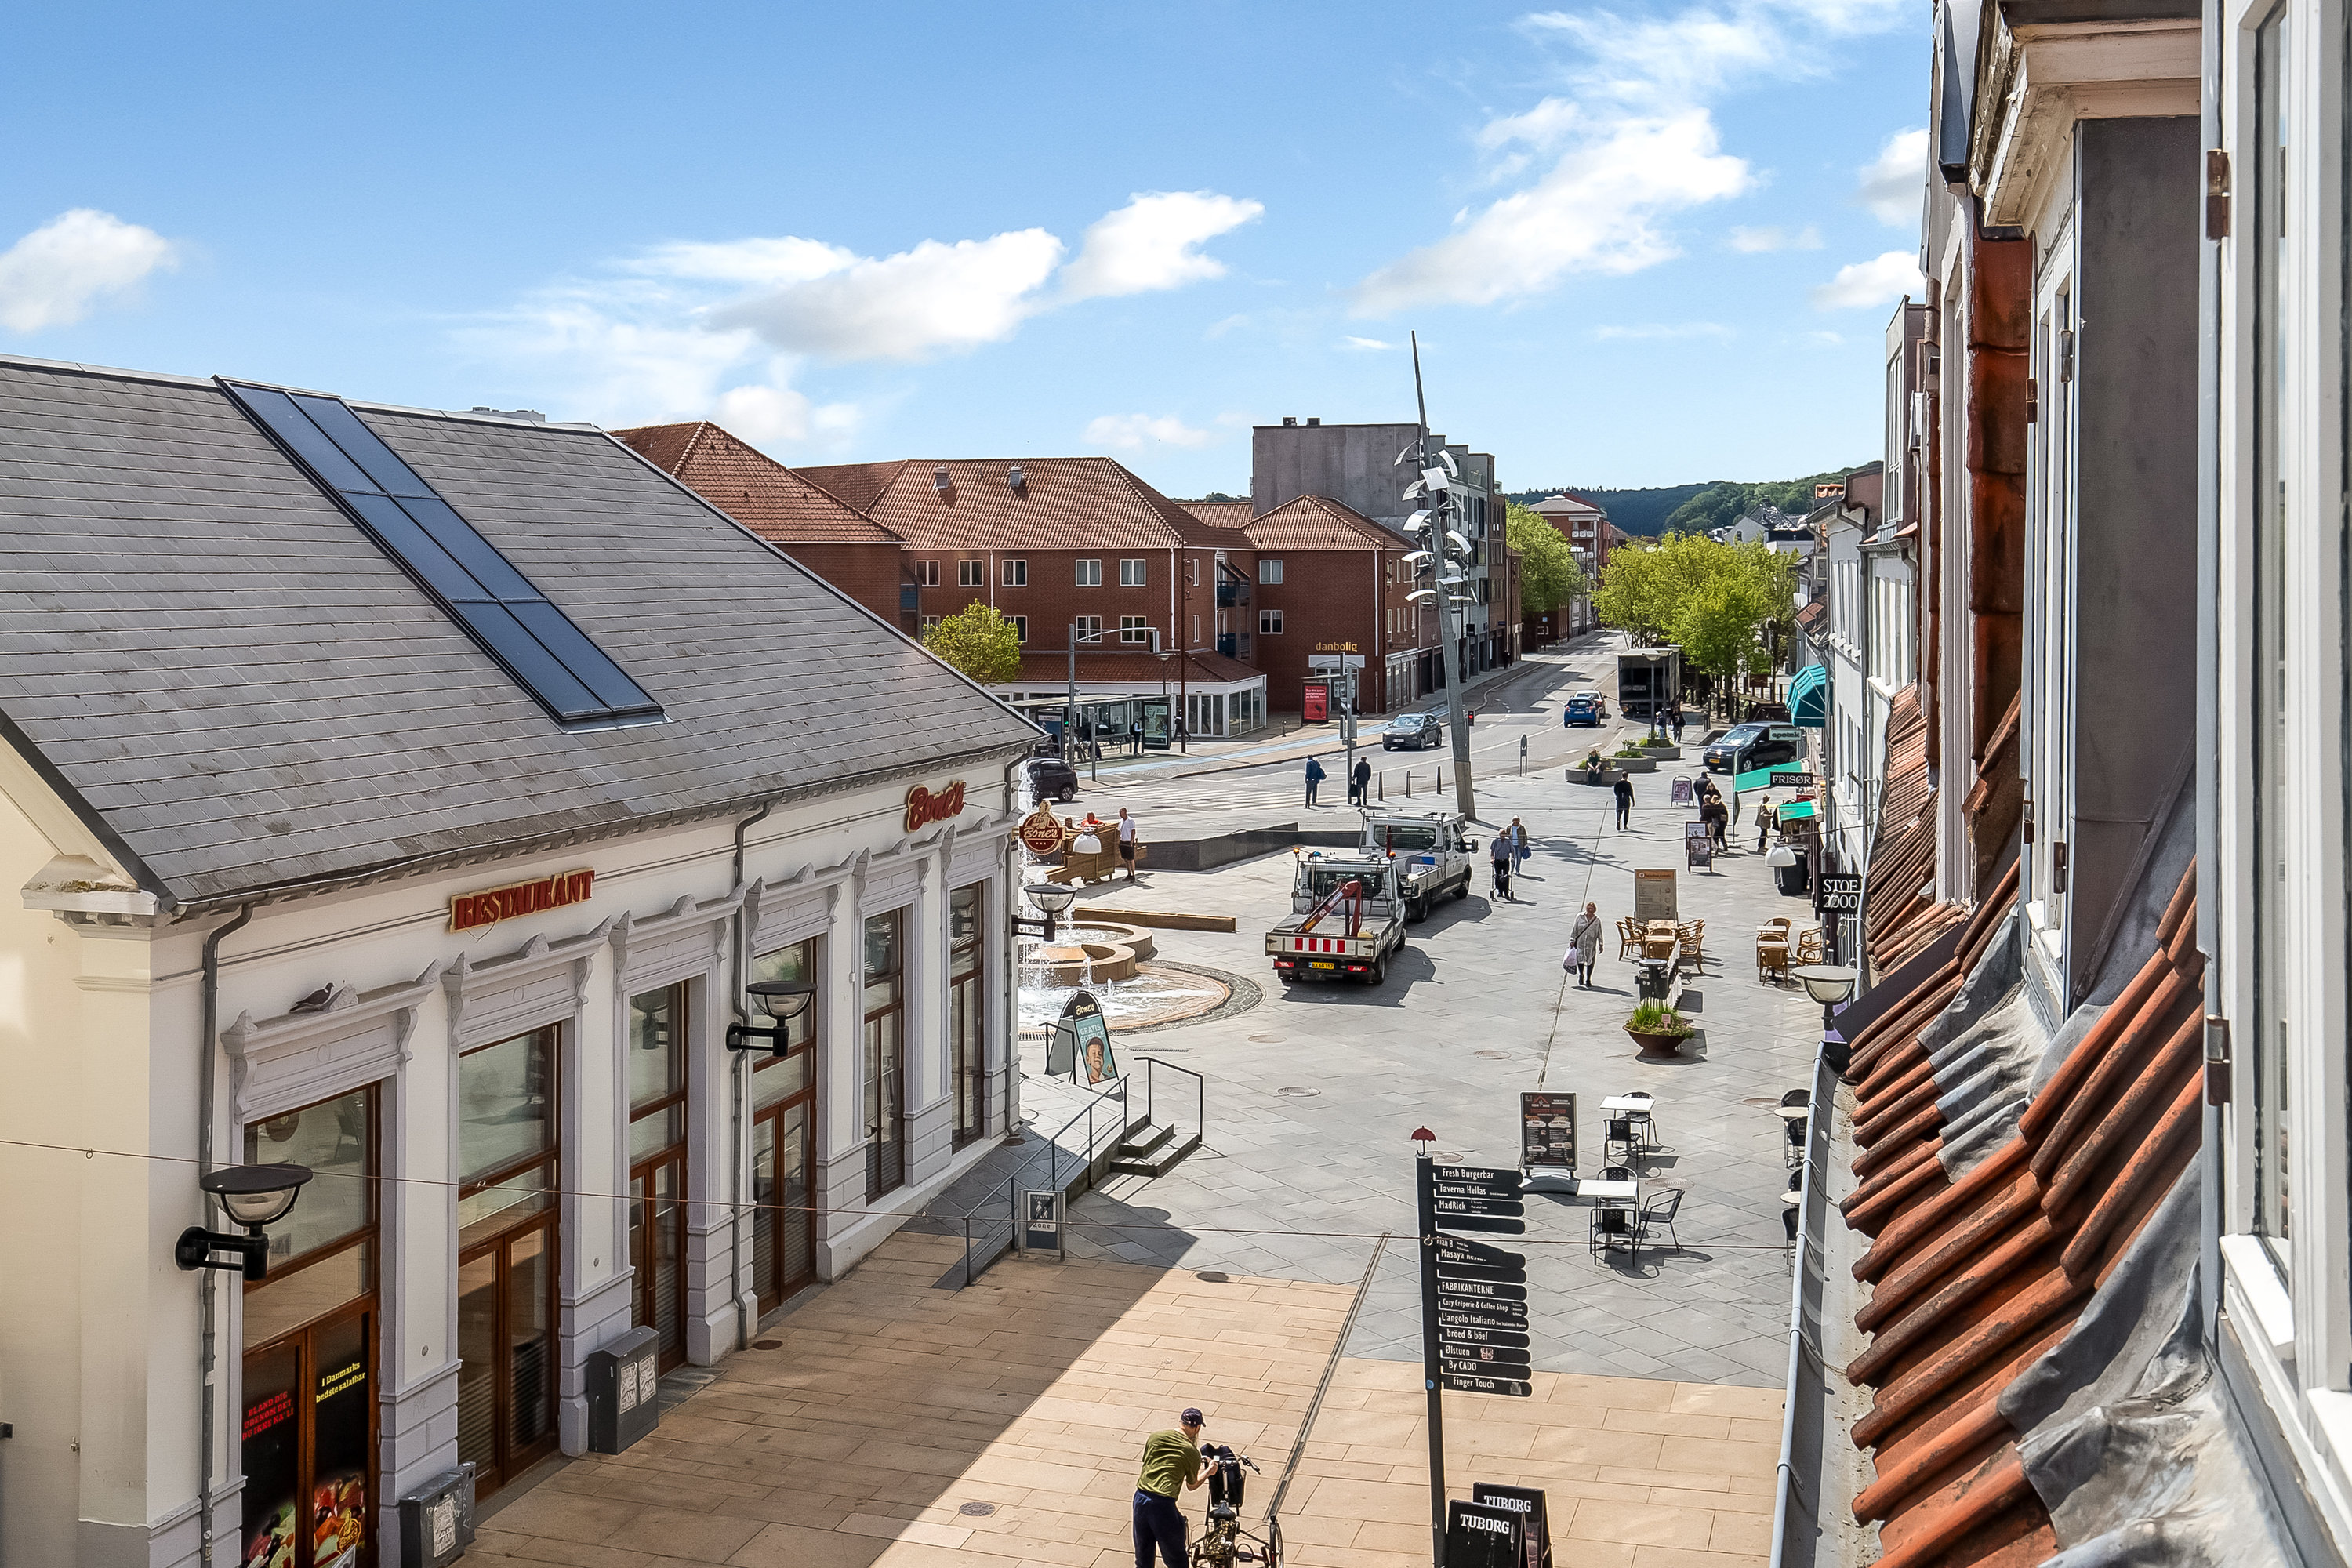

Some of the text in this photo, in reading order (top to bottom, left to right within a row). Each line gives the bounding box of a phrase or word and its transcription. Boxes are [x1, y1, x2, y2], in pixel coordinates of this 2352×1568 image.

[1316, 641, 1358, 652] danbolig
[1772, 775, 1811, 785] FRISØR
[1023, 827, 1059, 838] Bone's
[453, 869, 596, 931] RESTAURANT
[1823, 895, 1858, 909] 2000
[1075, 1003, 1095, 1015] Bone's
[1080, 1024, 1102, 1036] GRATIS
[1443, 1167, 1494, 1181] Fresh Burgerbar
[1439, 1184, 1465, 1194] Taverna
[1466, 1185, 1486, 1196] Hellas
[1439, 1200, 1466, 1210] MadRick
[1449, 1240, 1454, 1248] B
[1441, 1249, 1465, 1261] Masaya
[1442, 1282, 1494, 1295] FABRIKANTERNE
[1443, 1298, 1454, 1308] Cozy
[1454, 1299, 1475, 1308] Crêperie
[1480, 1301, 1496, 1310] Coffee
[1496, 1303, 1509, 1312] Shop
[1441, 1312, 1468, 1325] L'angolo
[1470, 1315, 1496, 1326] Italiano
[1467, 1330, 1472, 1339] &
[1445, 1345, 1470, 1356] Ølstuen
[1448, 1359, 1477, 1371] By CADO
[326, 1362, 361, 1385] Danmarks
[316, 1372, 365, 1403] bedste salatbar
[1453, 1376, 1494, 1389] Finger Touch
[248, 1390, 289, 1417] BLAND DIG
[277, 1399, 292, 1413] DET
[253, 1419, 272, 1435] IKKE
[1483, 1495, 1532, 1512] TUBORG
[1460, 1513, 1510, 1534] TUBORG
